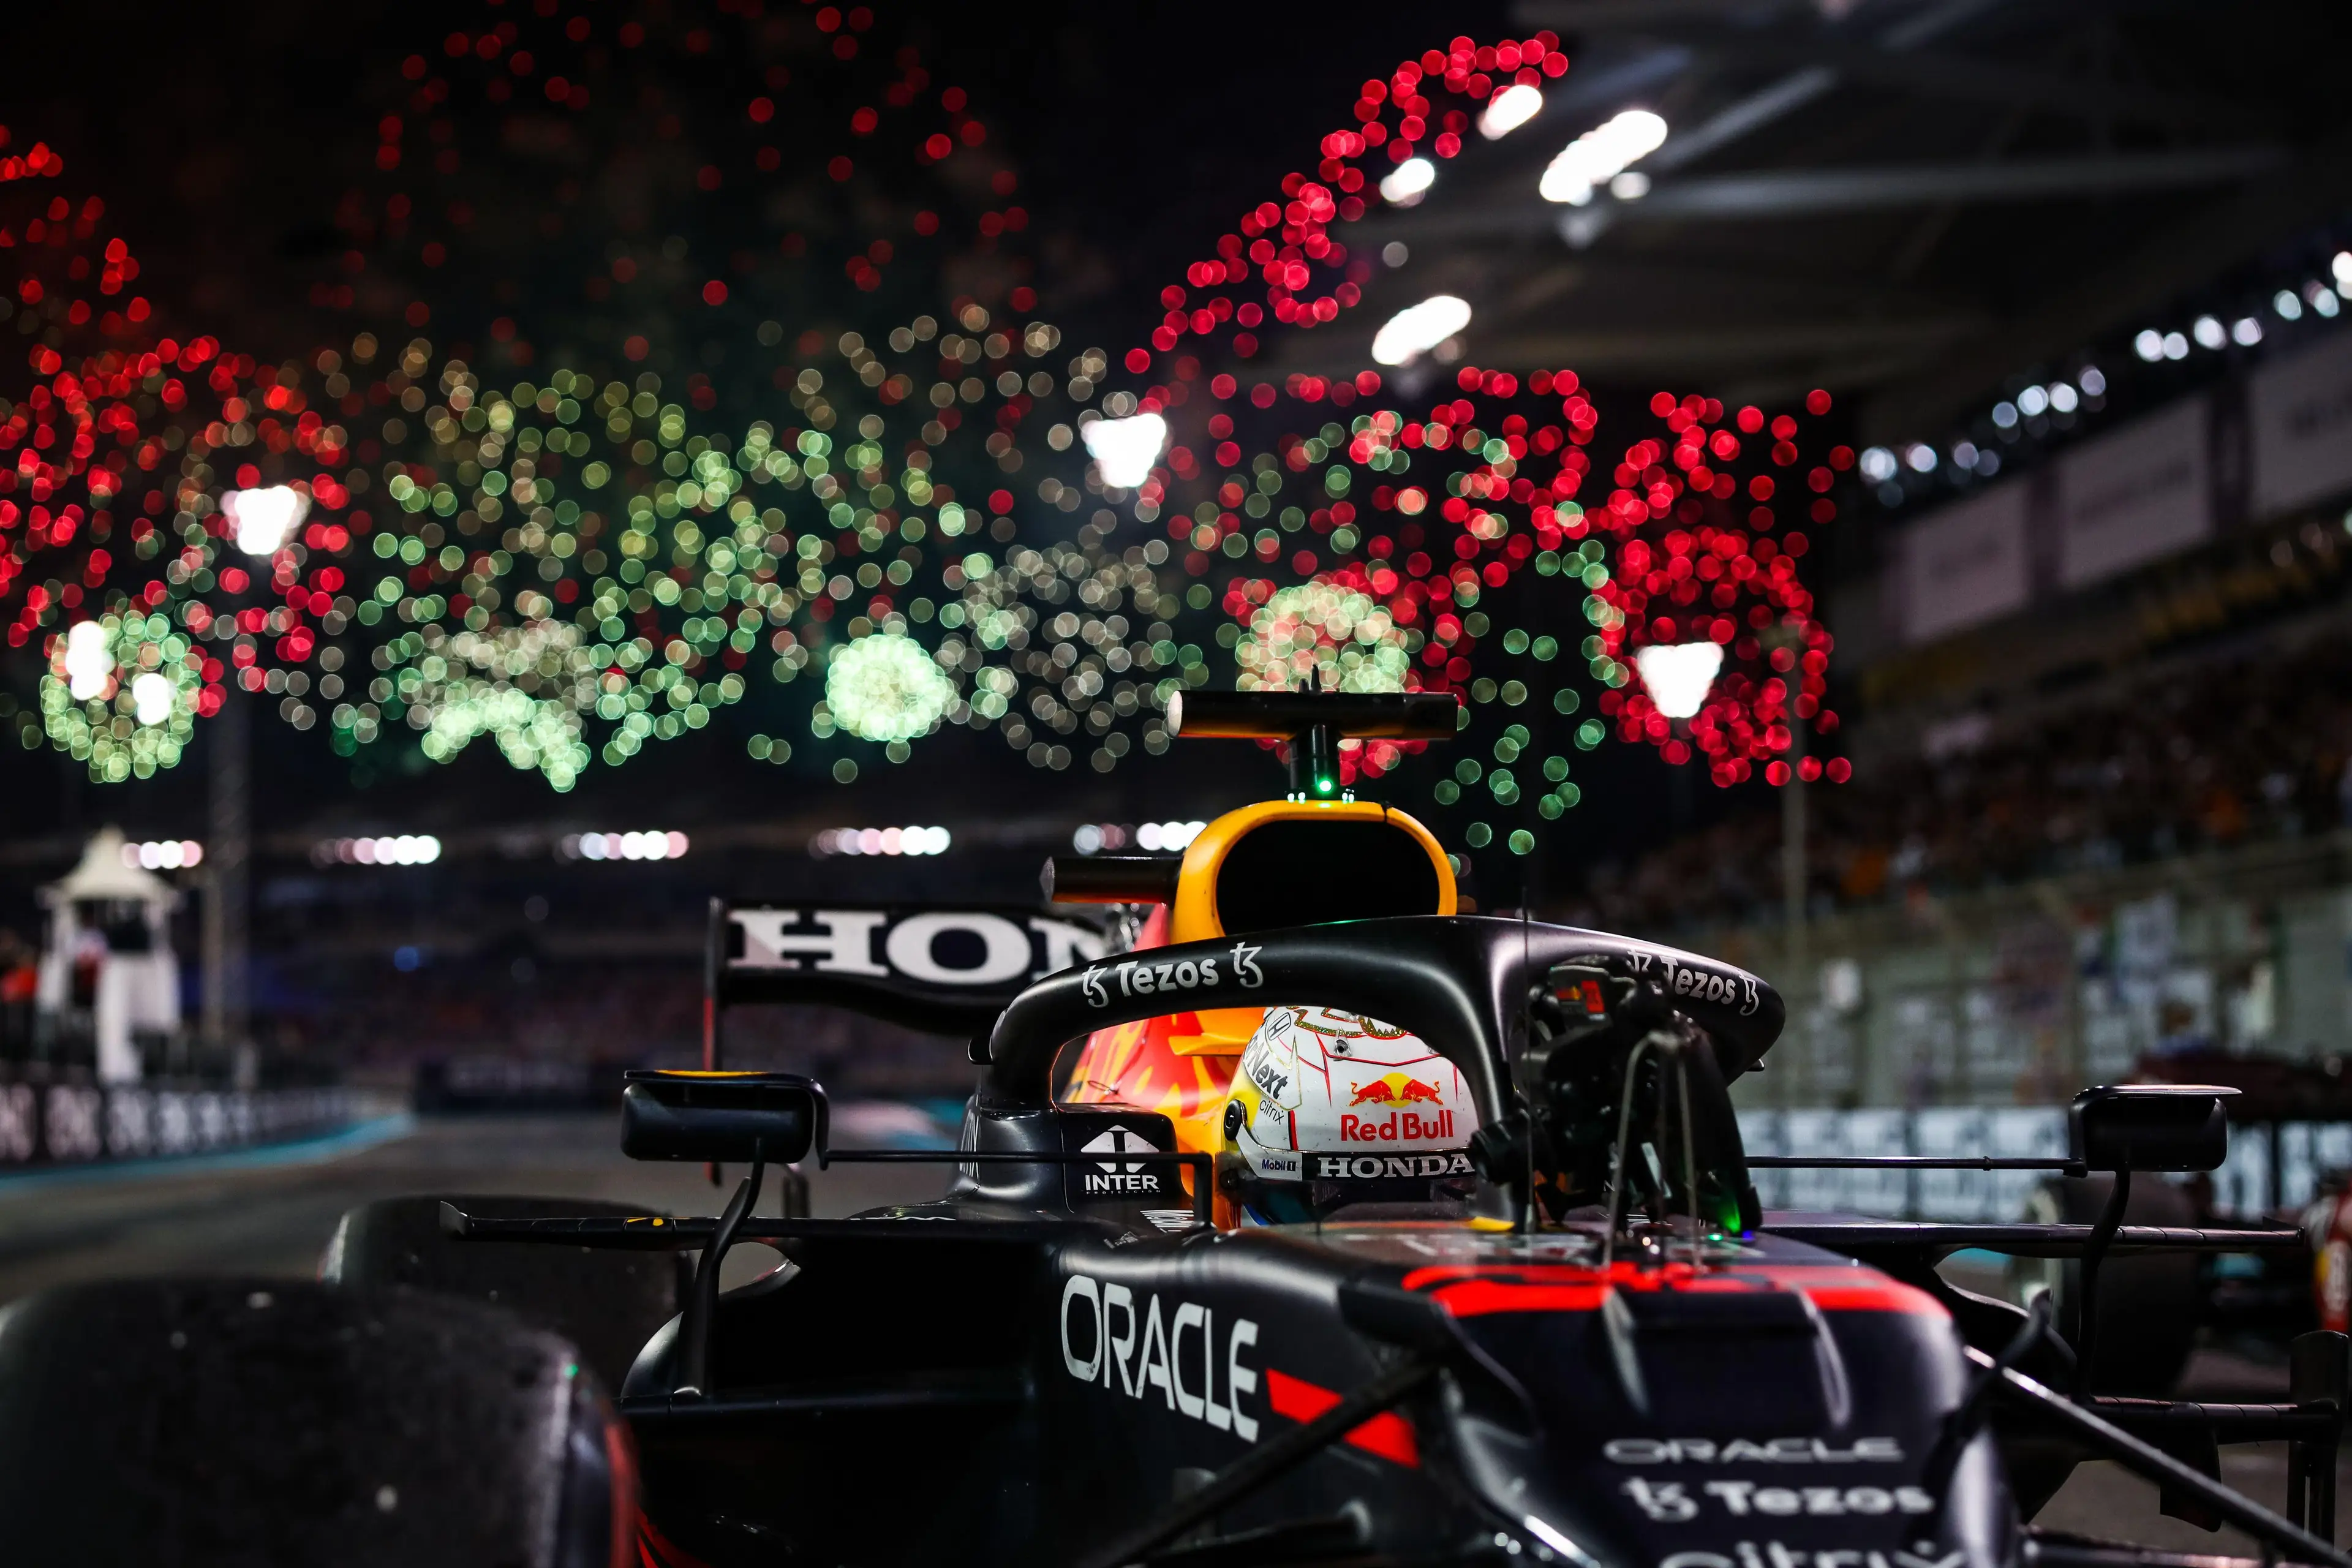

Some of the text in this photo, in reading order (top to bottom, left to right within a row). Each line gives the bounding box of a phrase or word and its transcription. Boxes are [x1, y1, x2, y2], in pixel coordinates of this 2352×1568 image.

[1115, 958, 1219, 997] Tezos
[1659, 956, 1736, 1005] Tezos
[1259, 1099, 1284, 1125] citrix
[1341, 1109, 1455, 1142] Red Bull
[1261, 1159, 1286, 1172] Mobil
[1317, 1153, 1476, 1178] HONDA
[1085, 1174, 1159, 1190] INTER
[1061, 1274, 1259, 1443] ORACLE
[1603, 1437, 1905, 1464] ORACLE
